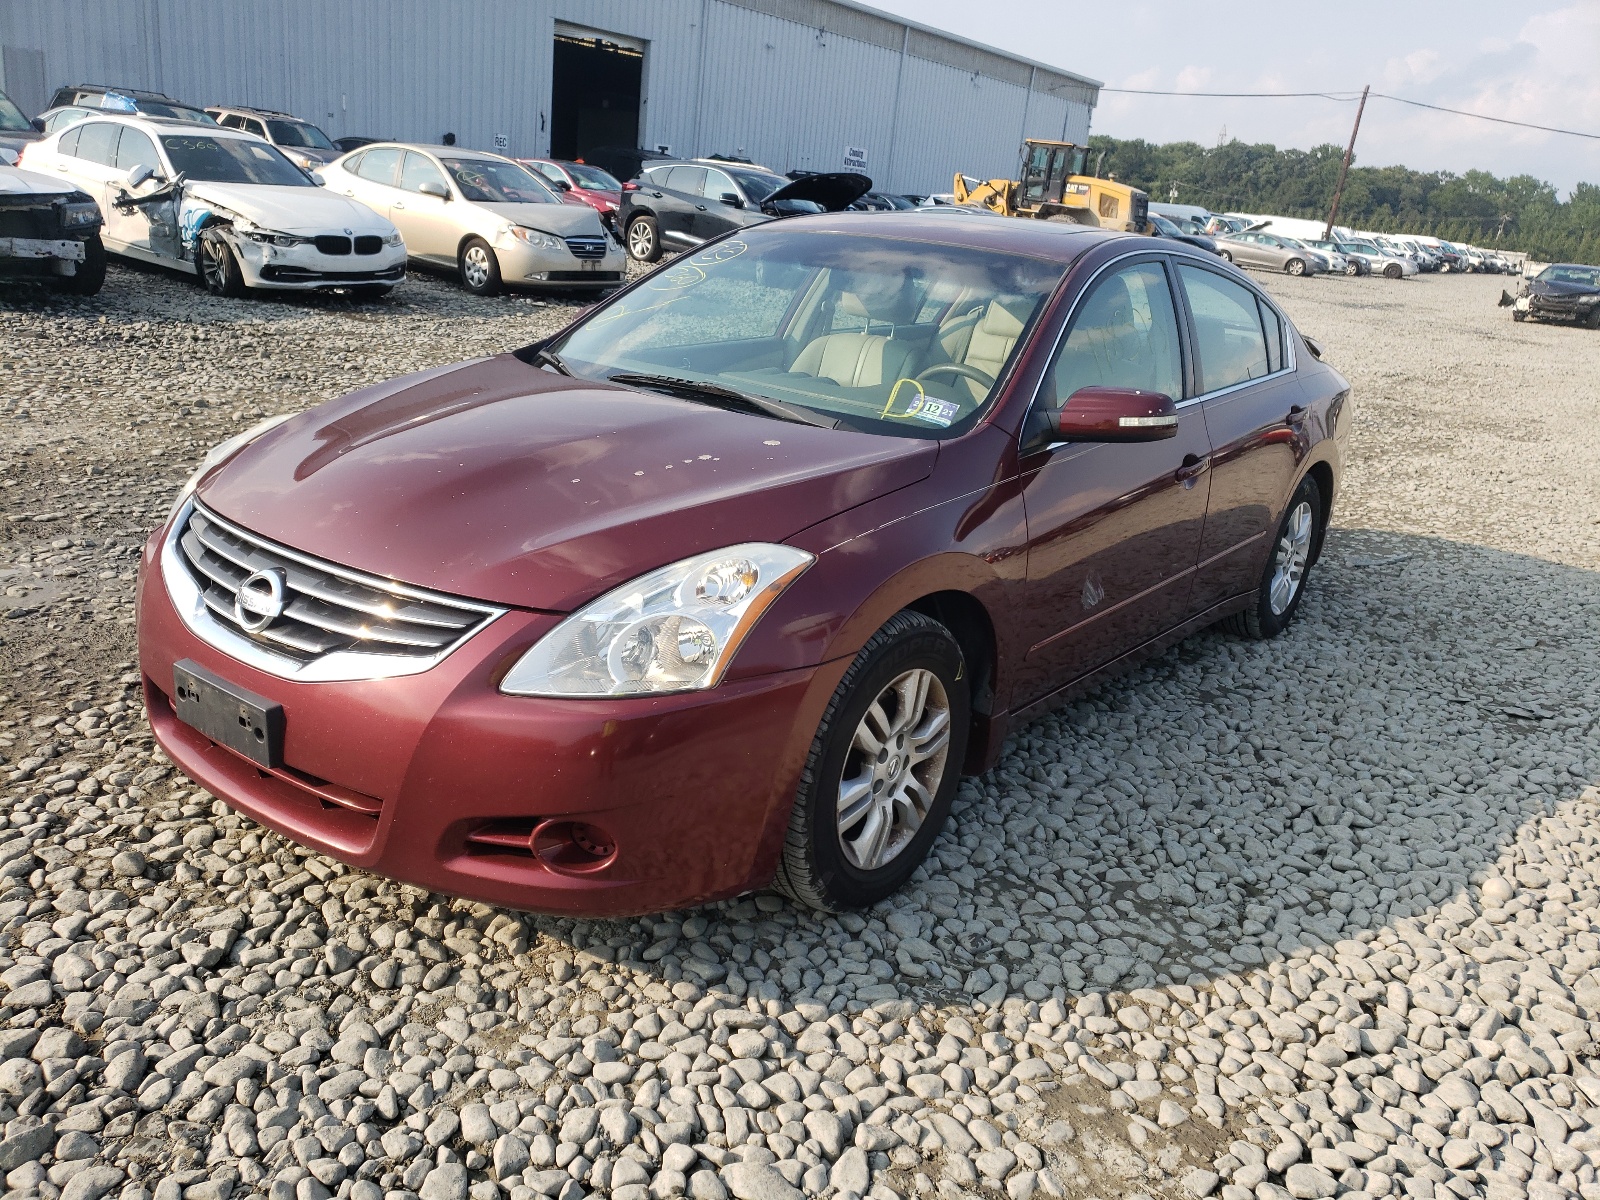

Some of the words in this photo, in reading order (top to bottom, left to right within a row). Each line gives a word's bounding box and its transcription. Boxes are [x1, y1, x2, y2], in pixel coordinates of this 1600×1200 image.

[494, 136, 507, 148] REC
[1066, 183, 1078, 193] CAT
[925, 403, 940, 414] 12
[942, 408, 954, 417] 21
[236, 593, 271, 613] NISSN
